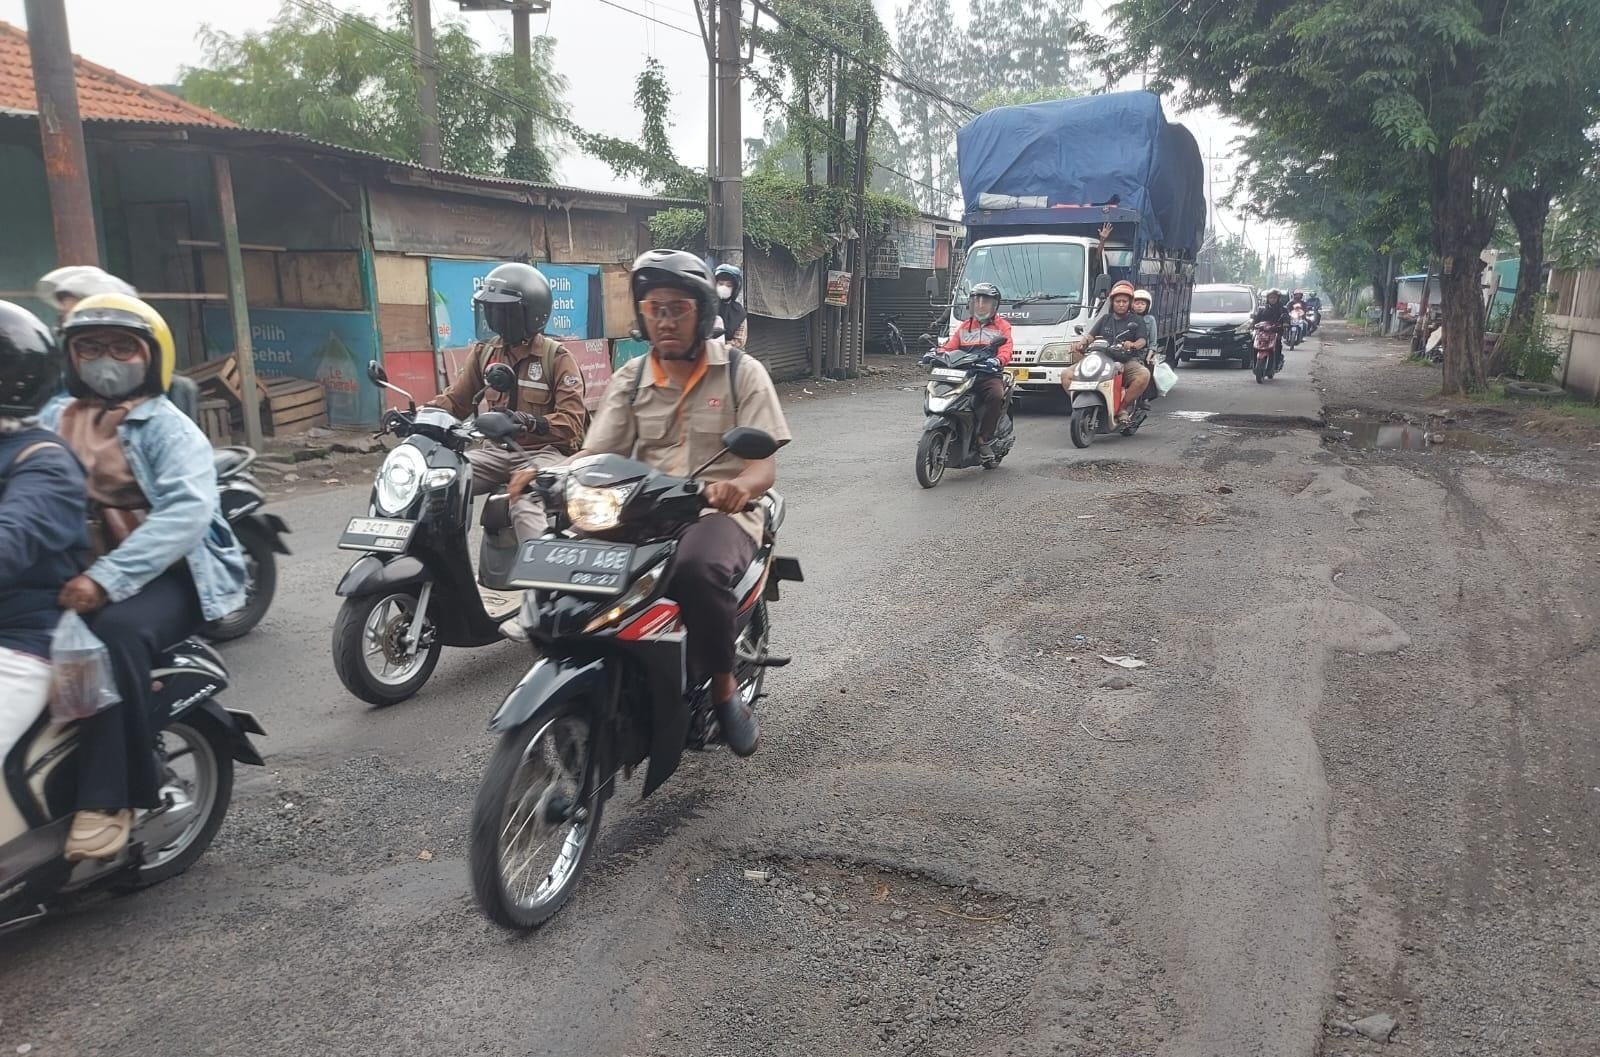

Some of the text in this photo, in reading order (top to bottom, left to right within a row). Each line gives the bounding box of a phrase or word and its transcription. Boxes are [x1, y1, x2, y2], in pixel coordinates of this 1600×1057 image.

[549, 278, 571, 291] Pilih
[552, 297, 575, 310] ehat
[553, 315, 571, 329] Pilih
[252, 324, 286, 341] Pilih
[523, 545, 536, 563] L
